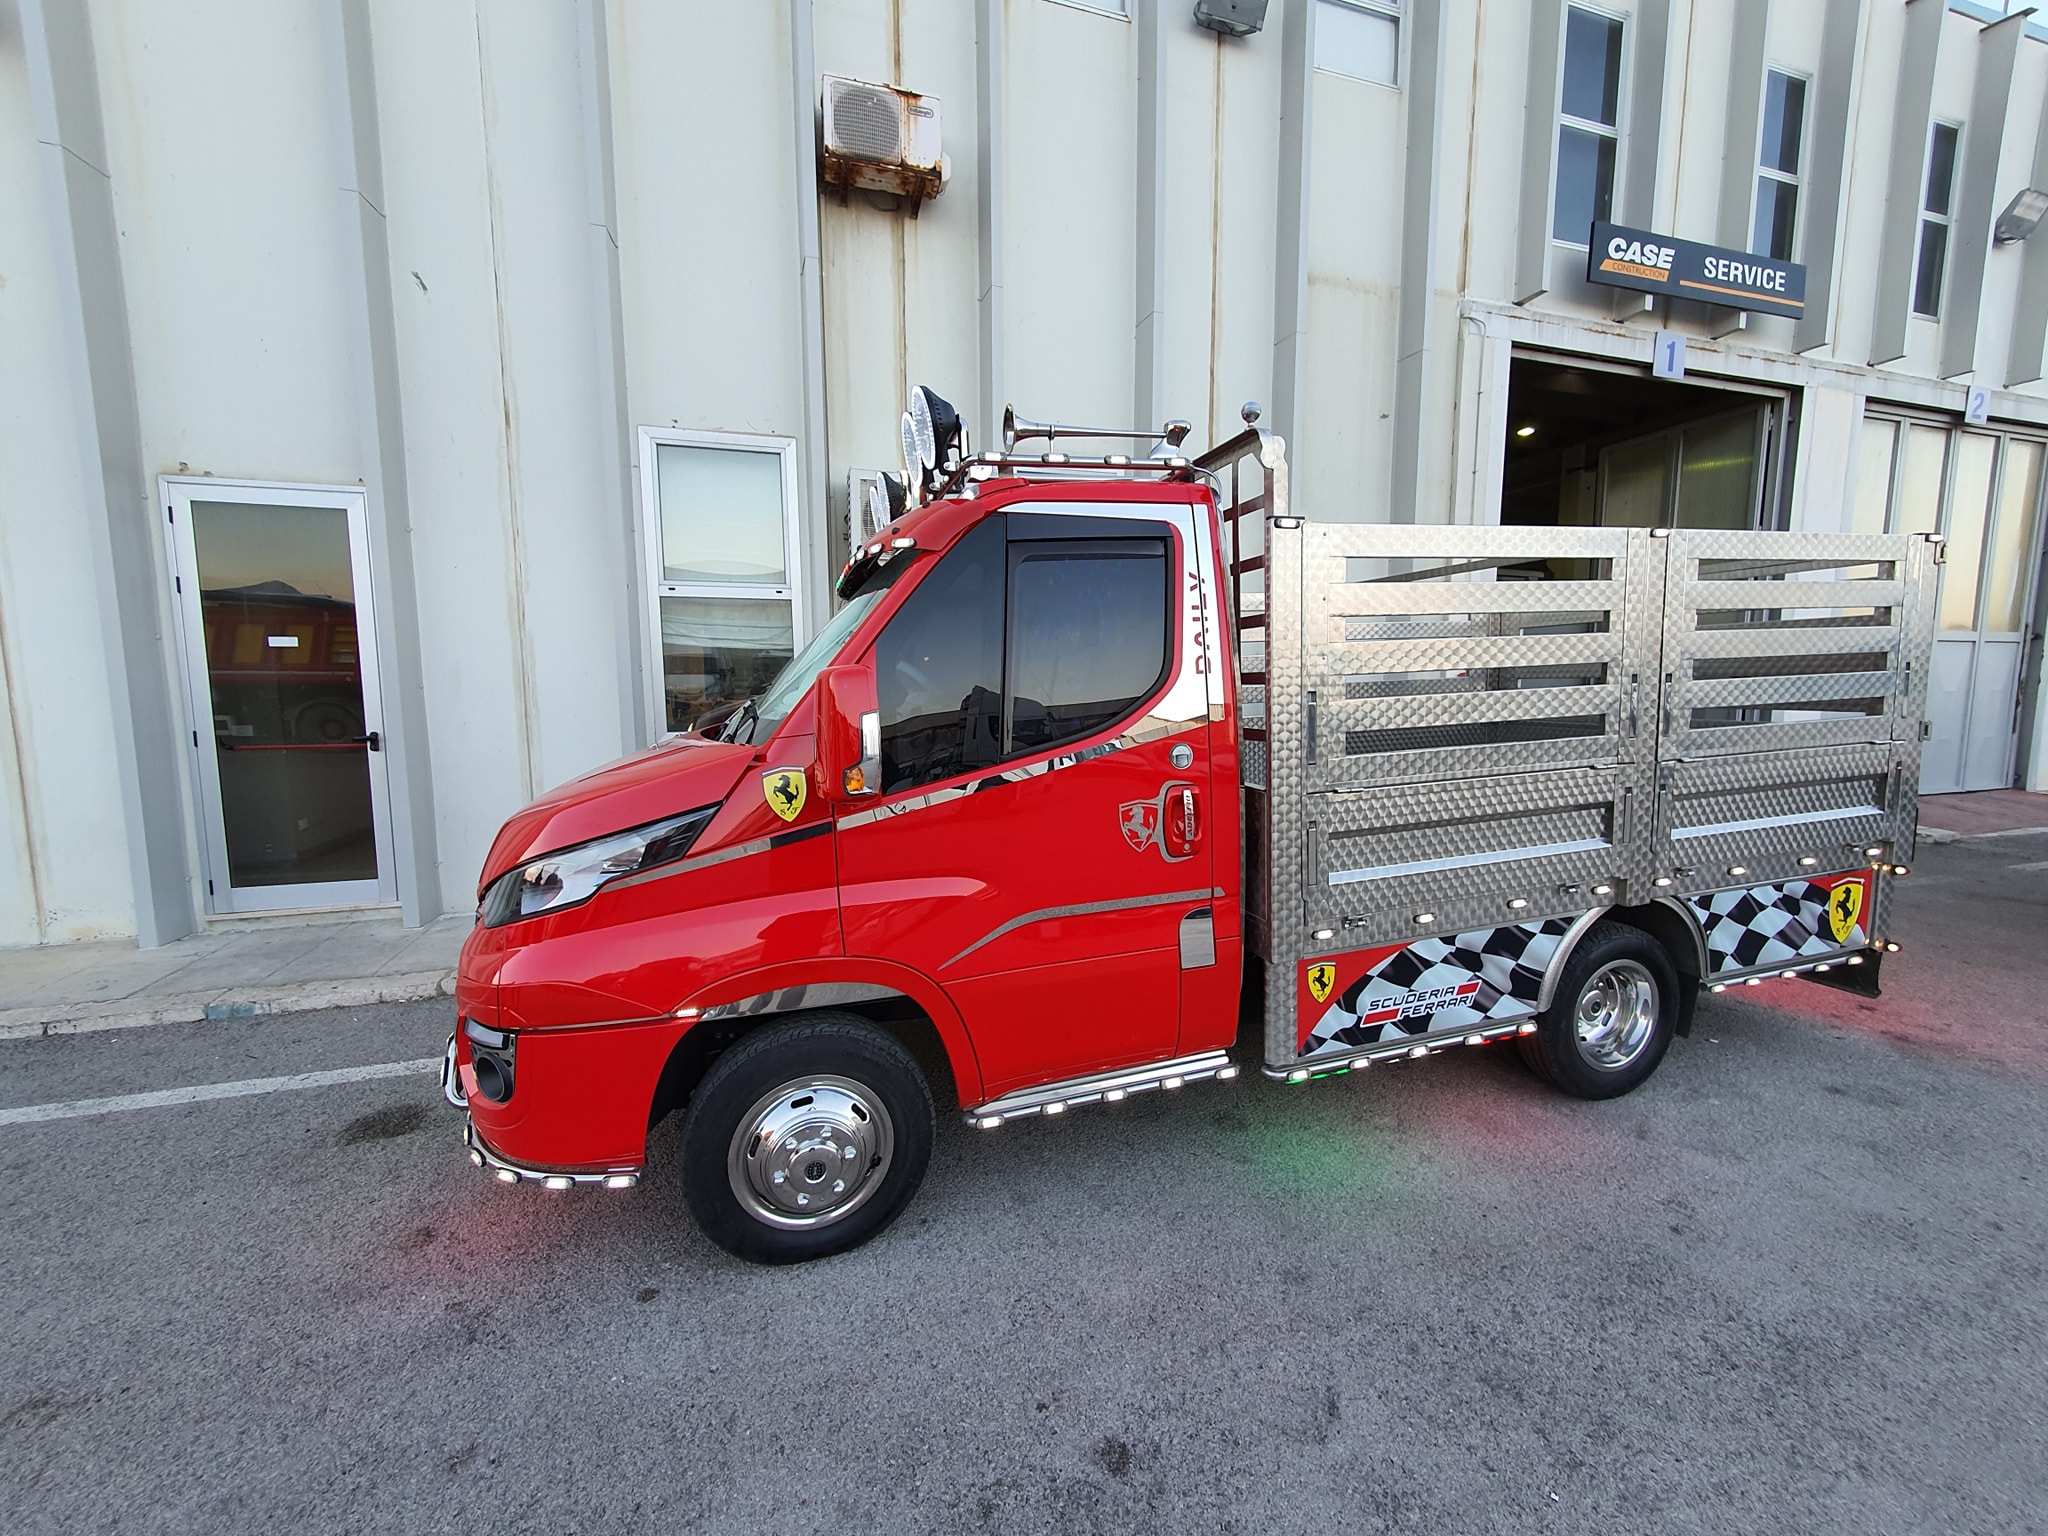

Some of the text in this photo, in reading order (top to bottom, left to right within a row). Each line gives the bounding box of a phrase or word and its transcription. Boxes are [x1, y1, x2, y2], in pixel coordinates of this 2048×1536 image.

[1607, 237, 1676, 270] CASE
[1612, 261, 1666, 280] CONSTRUCTION
[1704, 256, 1787, 292] SERVICE
[1666, 341, 1676, 372] 1
[1971, 392, 1985, 419] 2
[1368, 986, 1456, 1011] SCUDERIA
[1399, 995, 1474, 1018] FERRARI
